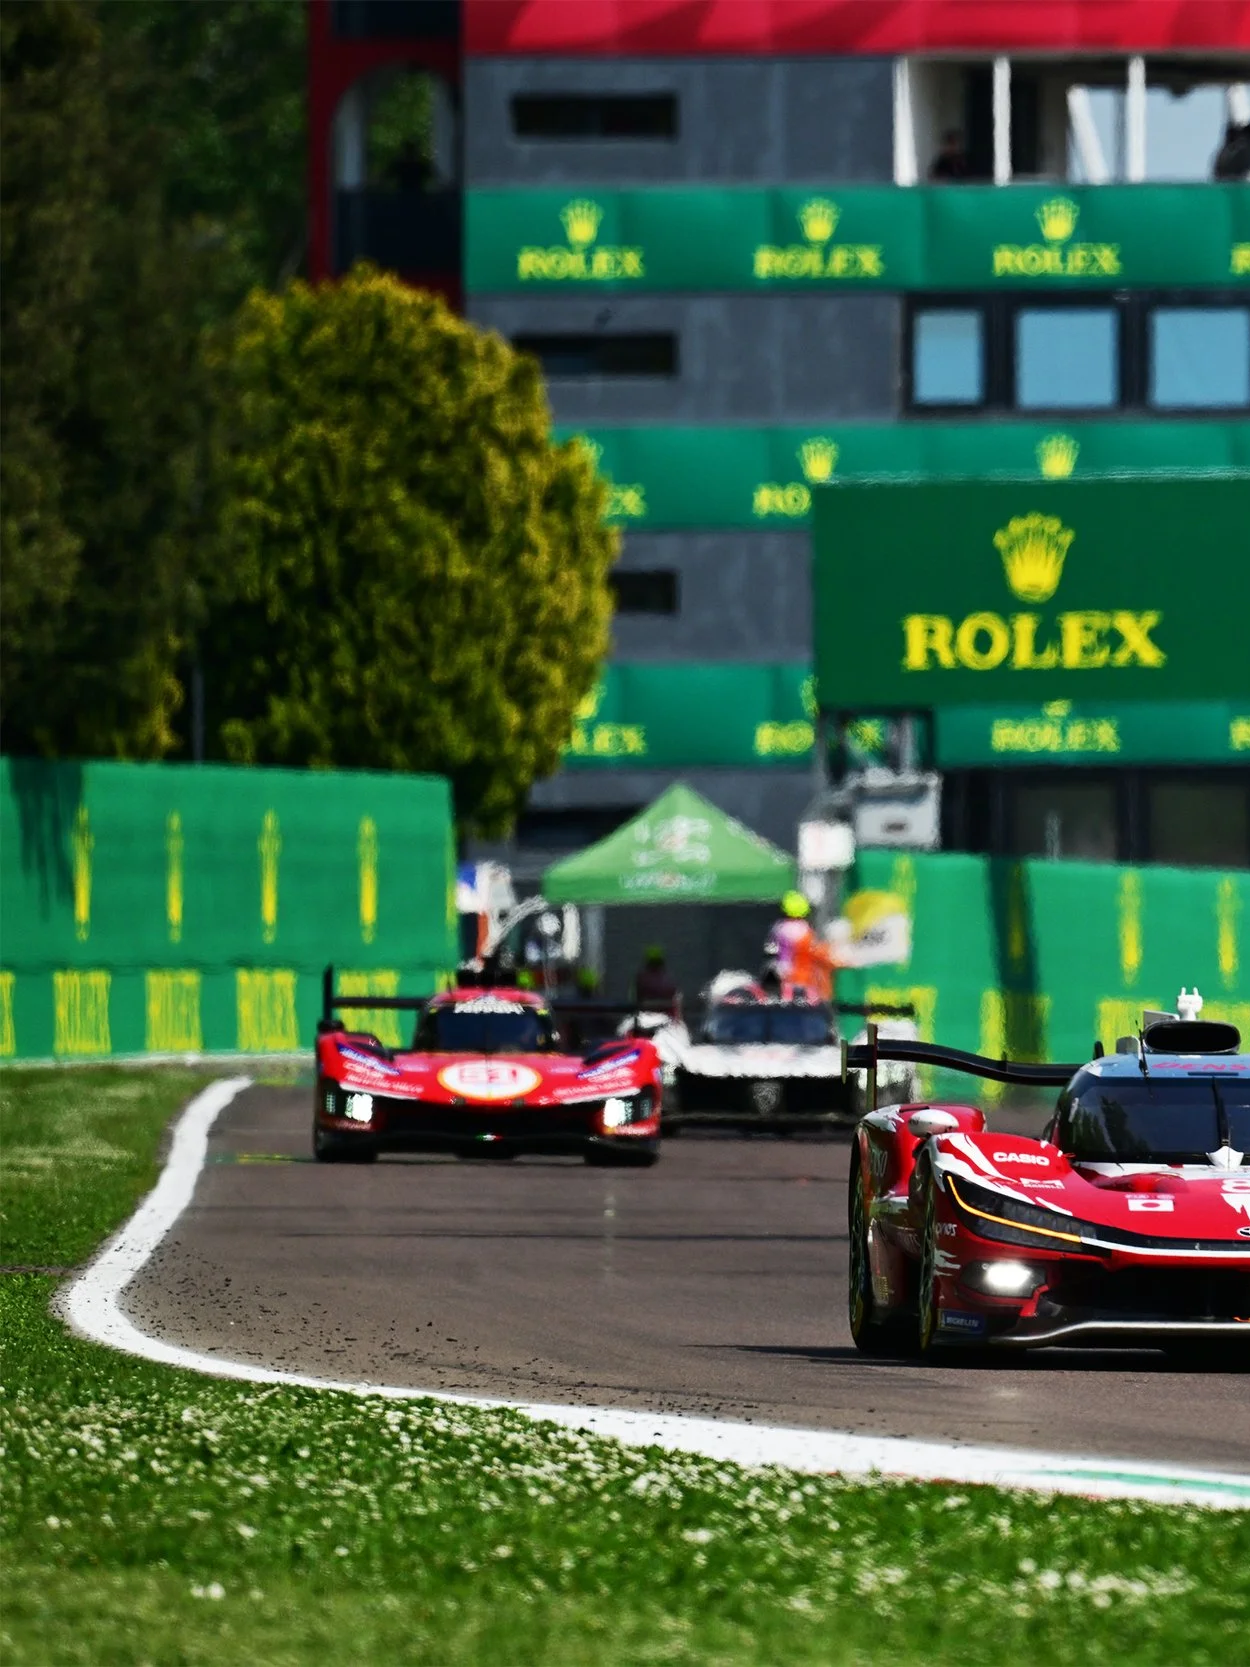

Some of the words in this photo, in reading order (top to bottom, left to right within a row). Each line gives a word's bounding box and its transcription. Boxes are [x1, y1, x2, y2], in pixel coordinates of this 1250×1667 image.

[517, 246, 644, 279] ROLEX
[753, 244, 884, 278] ROLEX
[992, 243, 1122, 276] ROLEX
[903, 610, 1166, 672] ROLEX
[991, 718, 1120, 753] ROLEX
[993, 1152, 1049, 1166] CASIO
